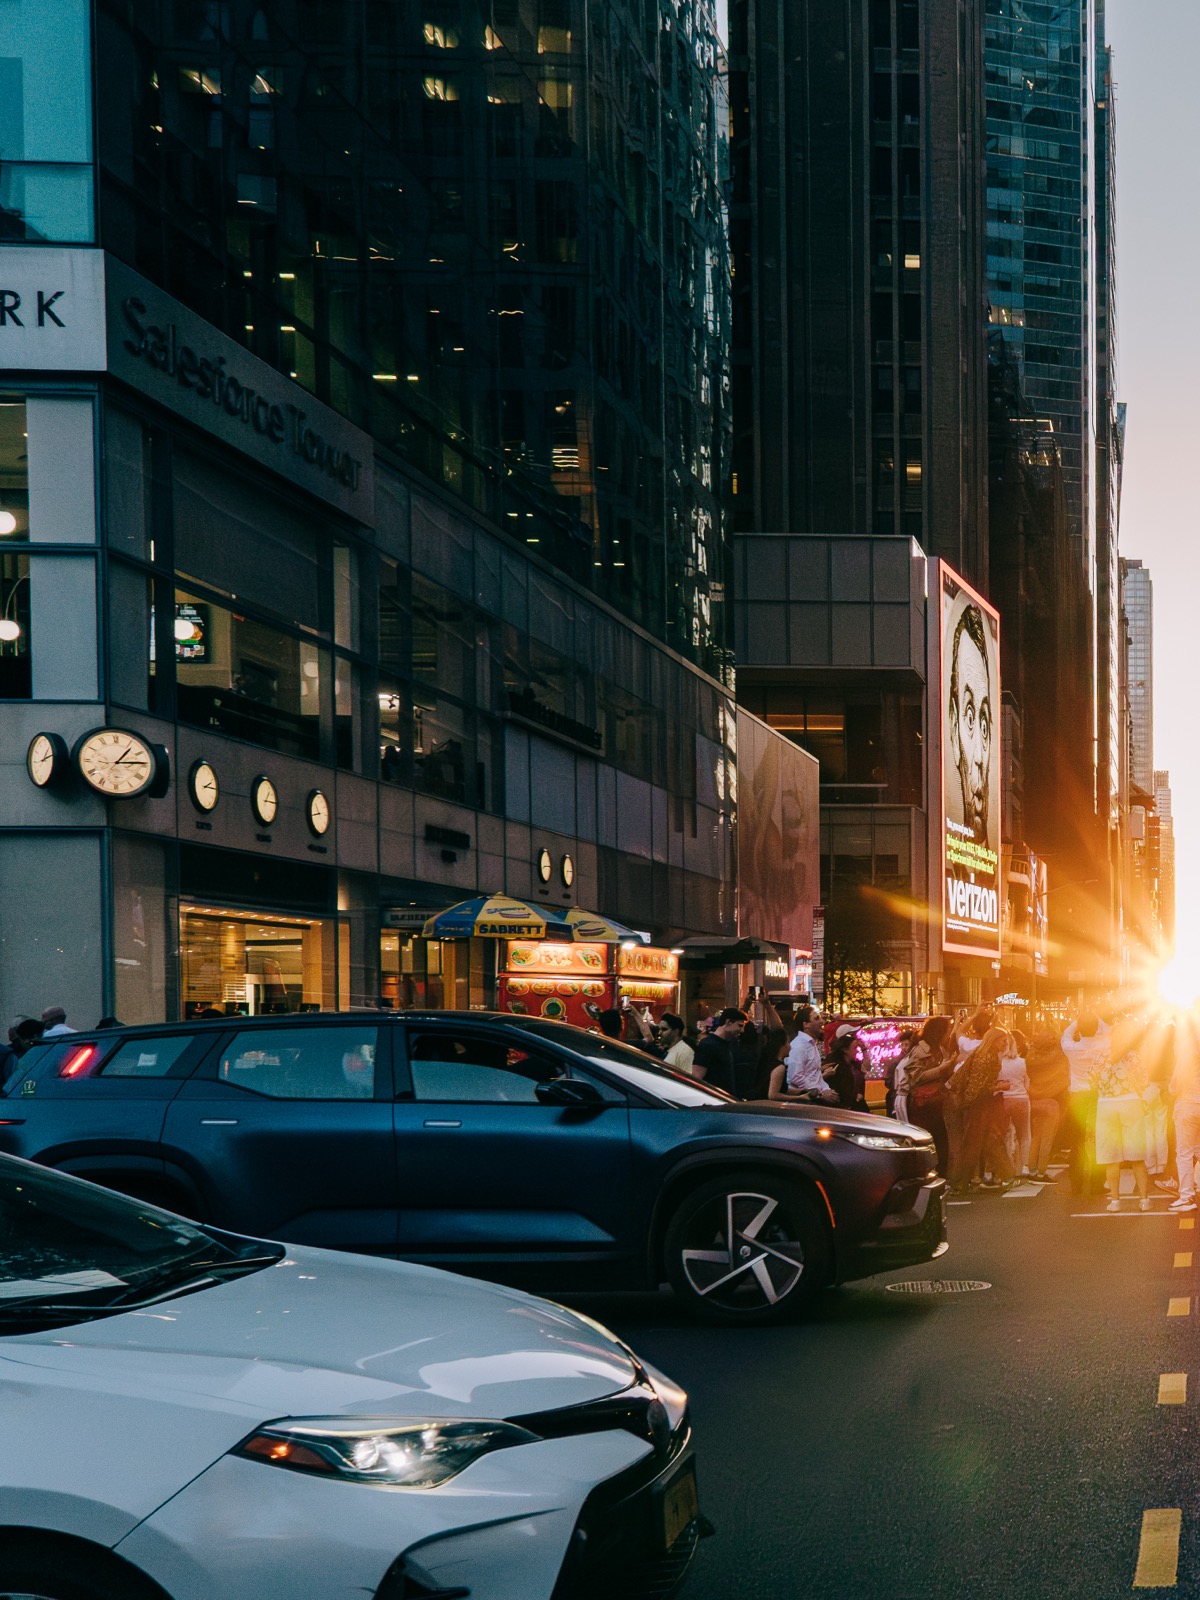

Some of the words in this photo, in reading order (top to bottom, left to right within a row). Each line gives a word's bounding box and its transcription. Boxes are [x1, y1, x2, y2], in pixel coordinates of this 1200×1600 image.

[122, 296, 285, 444] Salesforce
[286, 403, 363, 494] Tower
[946, 872, 998, 924] verizon
[479, 923, 543, 935] SABRETT
[765, 957, 788, 977] PANDORA
